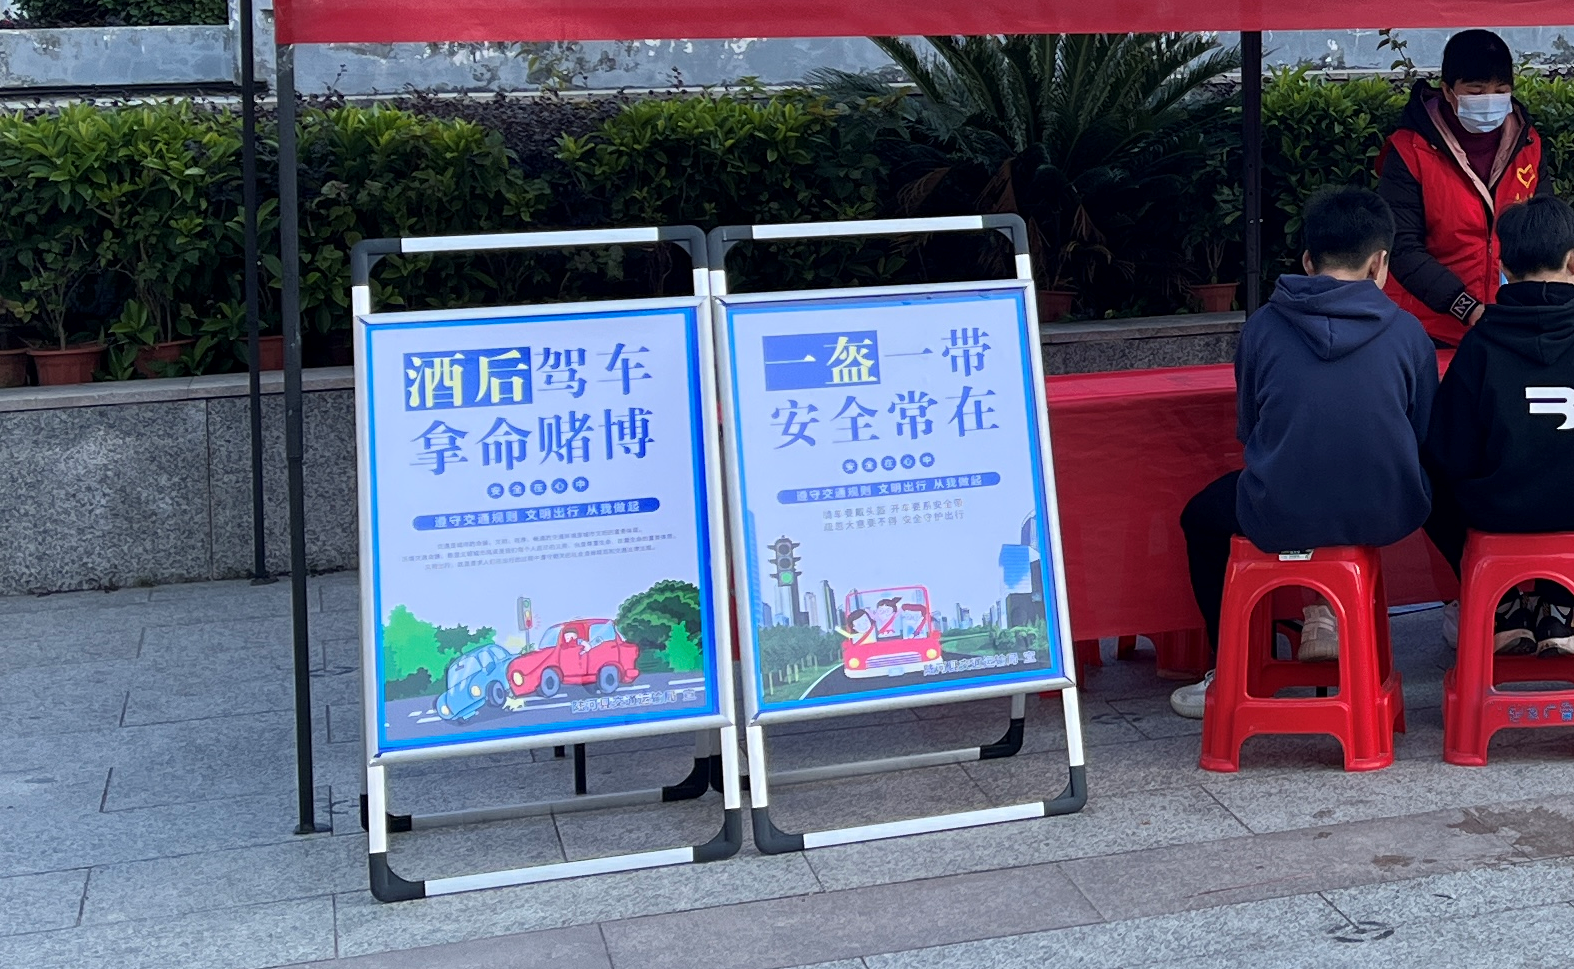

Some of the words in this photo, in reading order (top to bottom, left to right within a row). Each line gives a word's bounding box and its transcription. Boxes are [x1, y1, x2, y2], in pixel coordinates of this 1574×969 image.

[405, 342, 652, 408] 酒后驾车
[765, 327, 990, 385] 一盔一带
[769, 386, 1000, 450] 安全常在
[409, 408, 656, 476] 拿命赌博
[844, 454, 934, 473] 安全在心中
[878, 479, 926, 494] 文明出行
[933, 475, 981, 489] 从我做起
[489, 478, 588, 497] 安全在心中
[435, 510, 518, 527] 遵守交通规则
[525, 506, 579, 521] 文明出行
[586, 500, 640, 515] 从我做起
